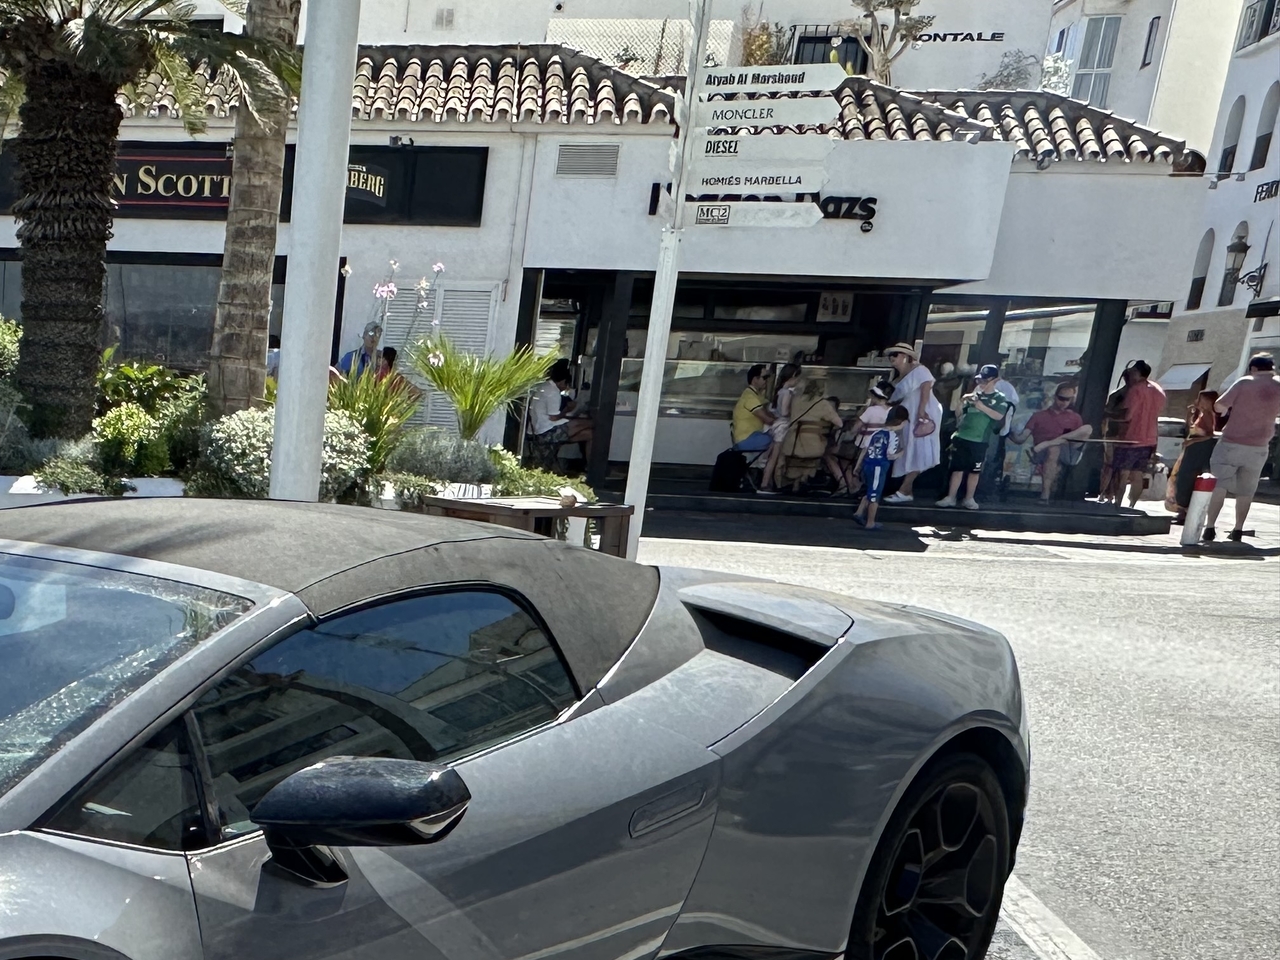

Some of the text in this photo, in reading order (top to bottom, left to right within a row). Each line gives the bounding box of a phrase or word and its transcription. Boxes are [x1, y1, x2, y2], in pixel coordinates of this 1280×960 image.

[712, 108, 774, 121] MONCLER
[705, 140, 739, 154] DIESEL
[348, 170, 384, 198] BERG
